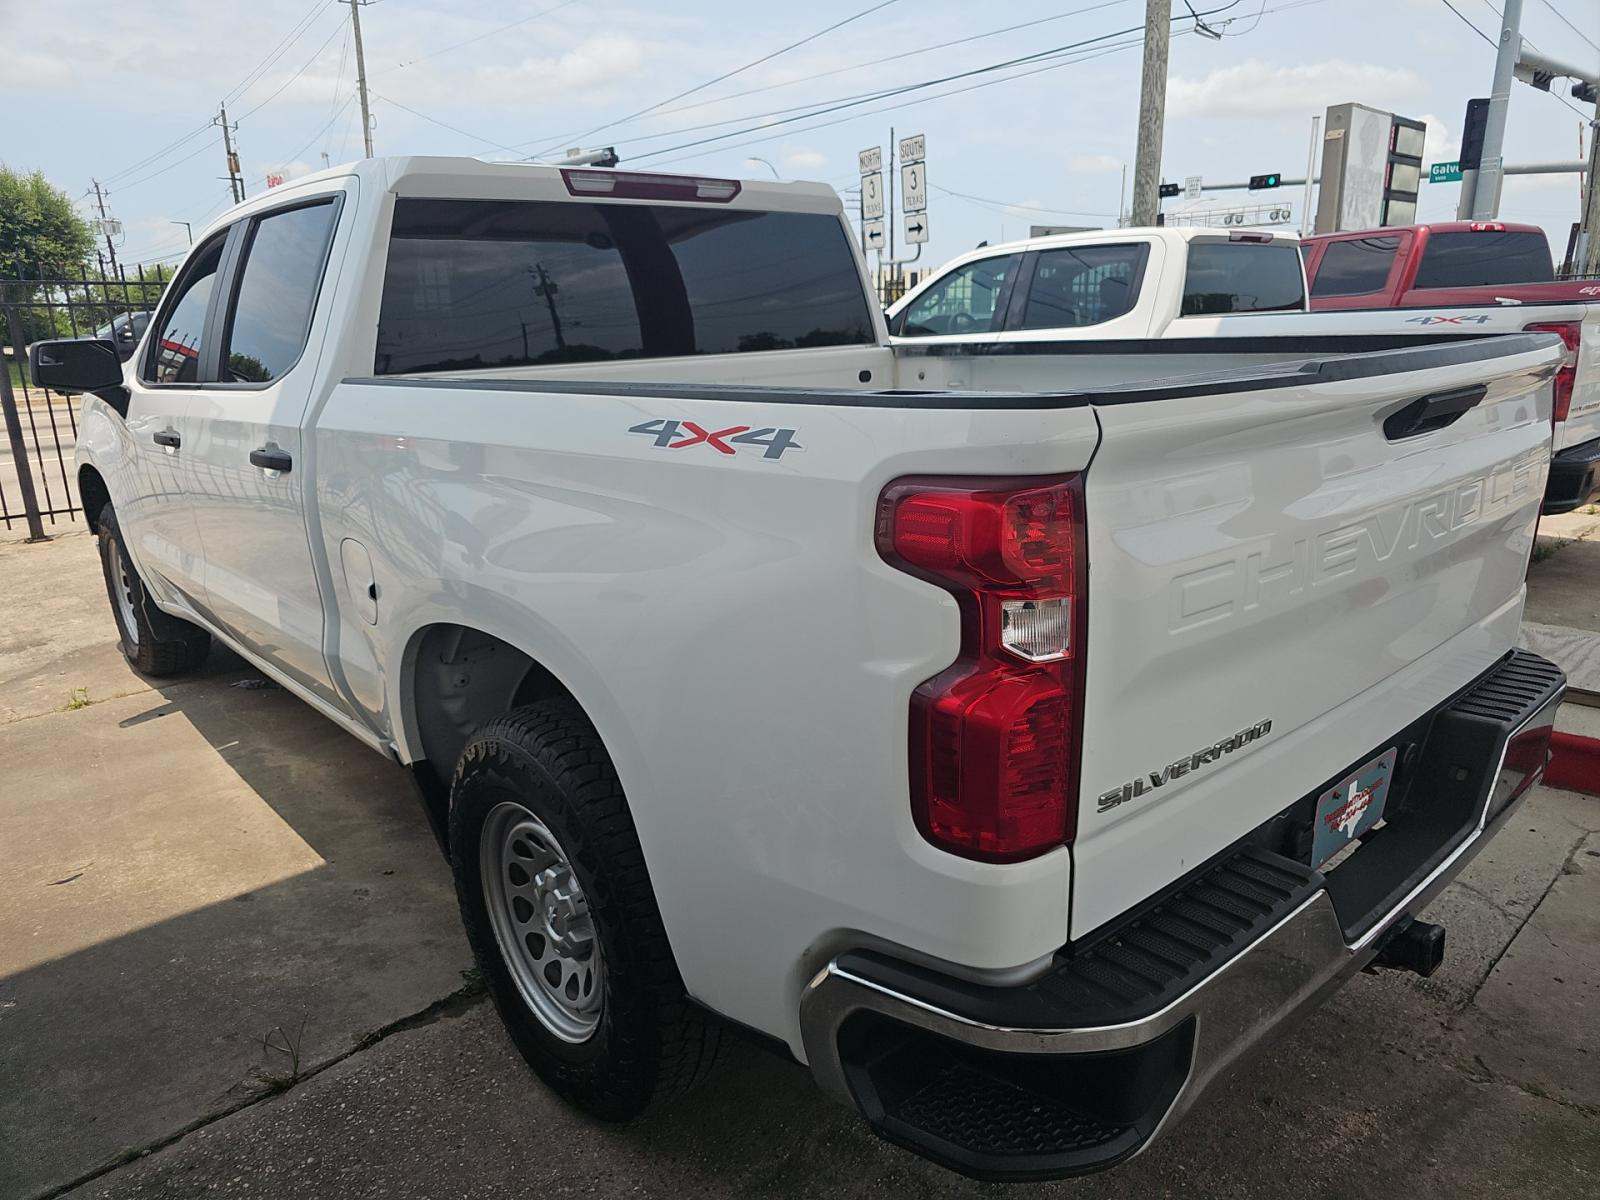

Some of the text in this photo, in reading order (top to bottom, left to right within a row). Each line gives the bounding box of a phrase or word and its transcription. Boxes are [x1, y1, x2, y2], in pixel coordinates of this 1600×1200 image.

[900, 139, 924, 158] SOUTH
[860, 152, 880, 169] NORTH
[869, 180, 876, 199] 3
[910, 169, 918, 191] 3
[1404, 314, 1492, 325] 4X4
[628, 419, 803, 460] 4X4
[1097, 718, 1273, 813] SILVERADO
